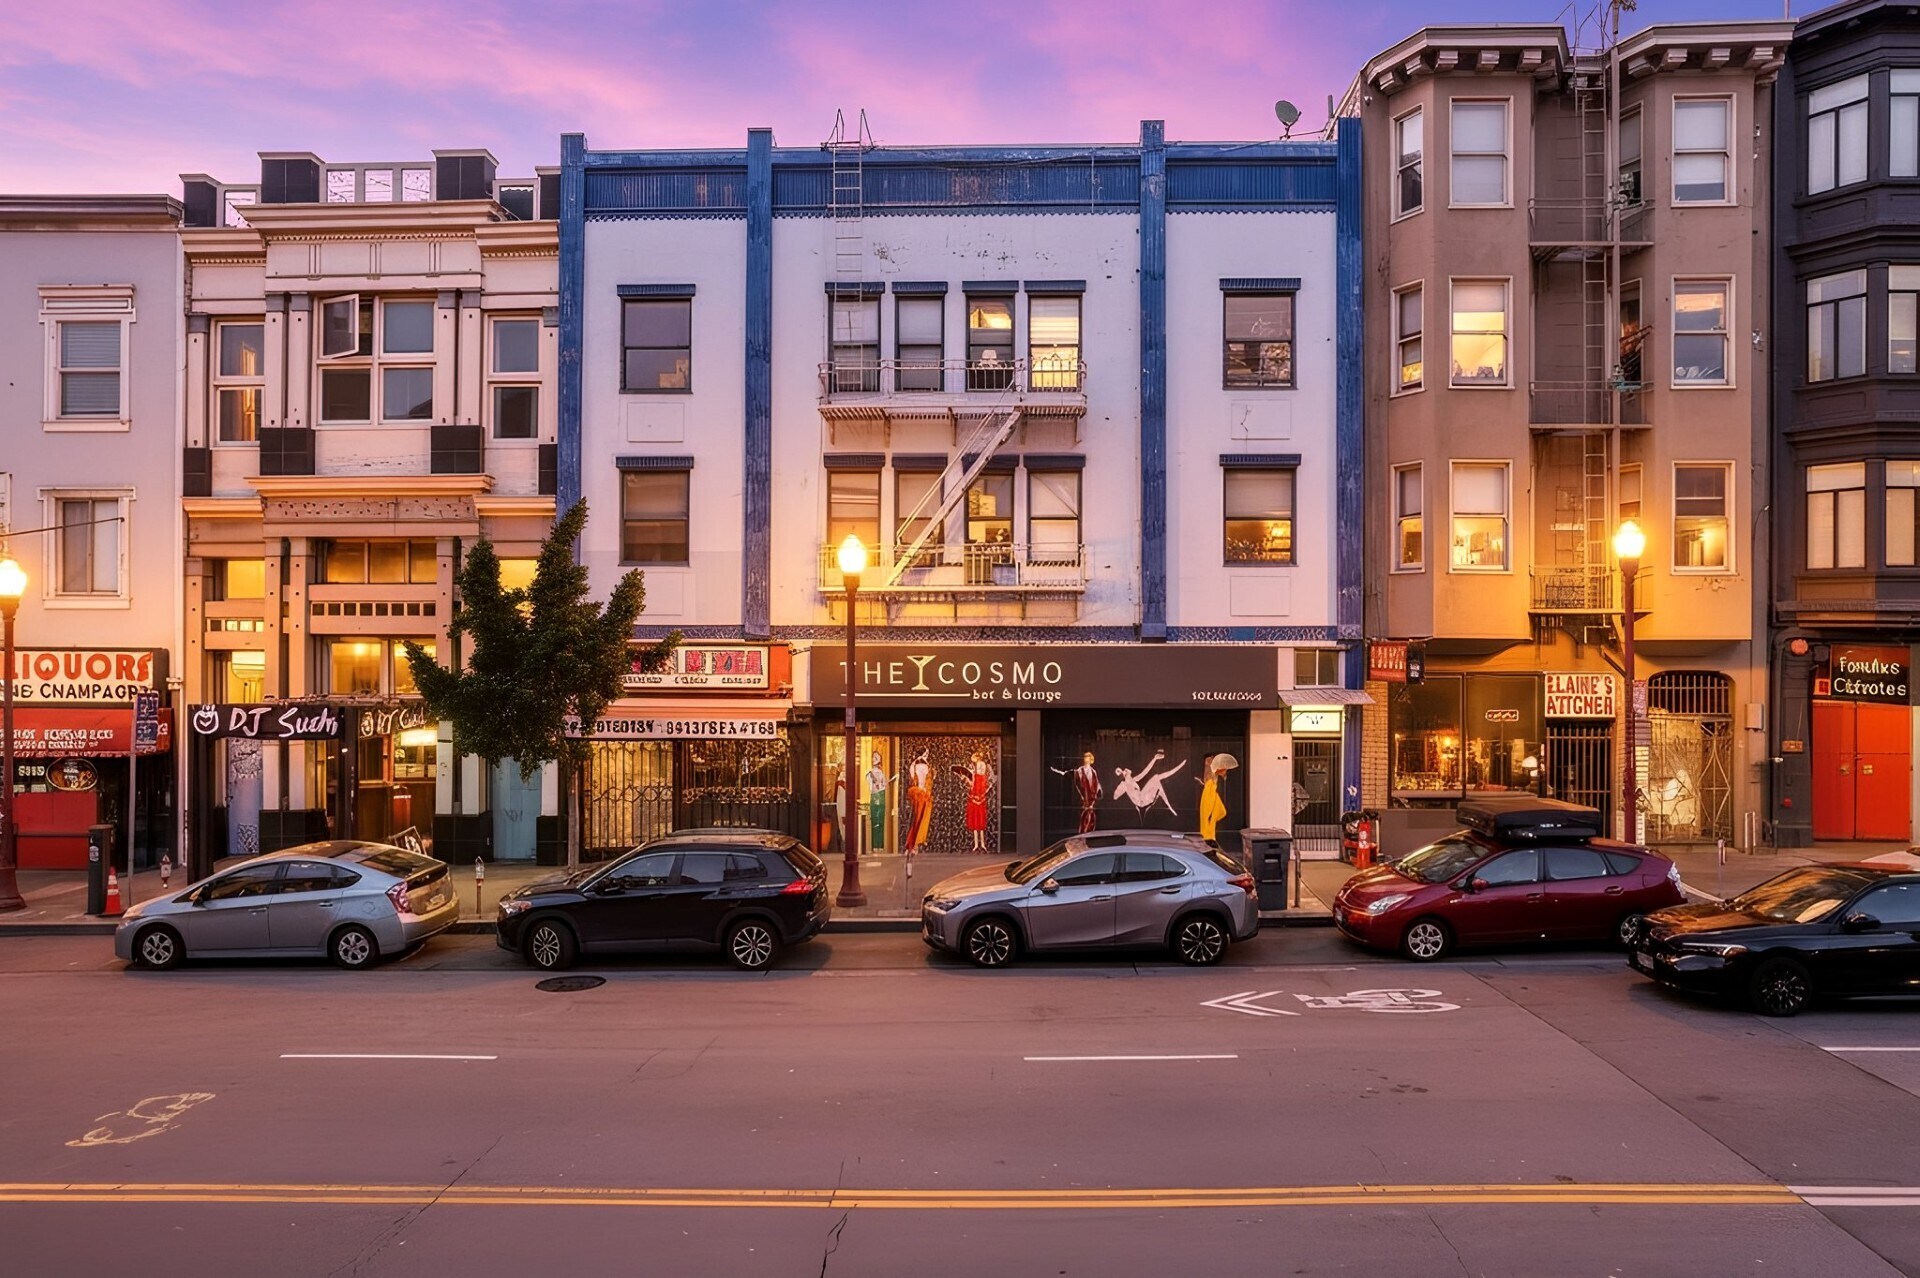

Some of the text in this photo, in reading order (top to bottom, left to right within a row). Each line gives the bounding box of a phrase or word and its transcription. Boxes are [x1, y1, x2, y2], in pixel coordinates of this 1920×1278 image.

[840, 662, 1062, 684] THE COSMO
[229, 707, 272, 737] DJ
